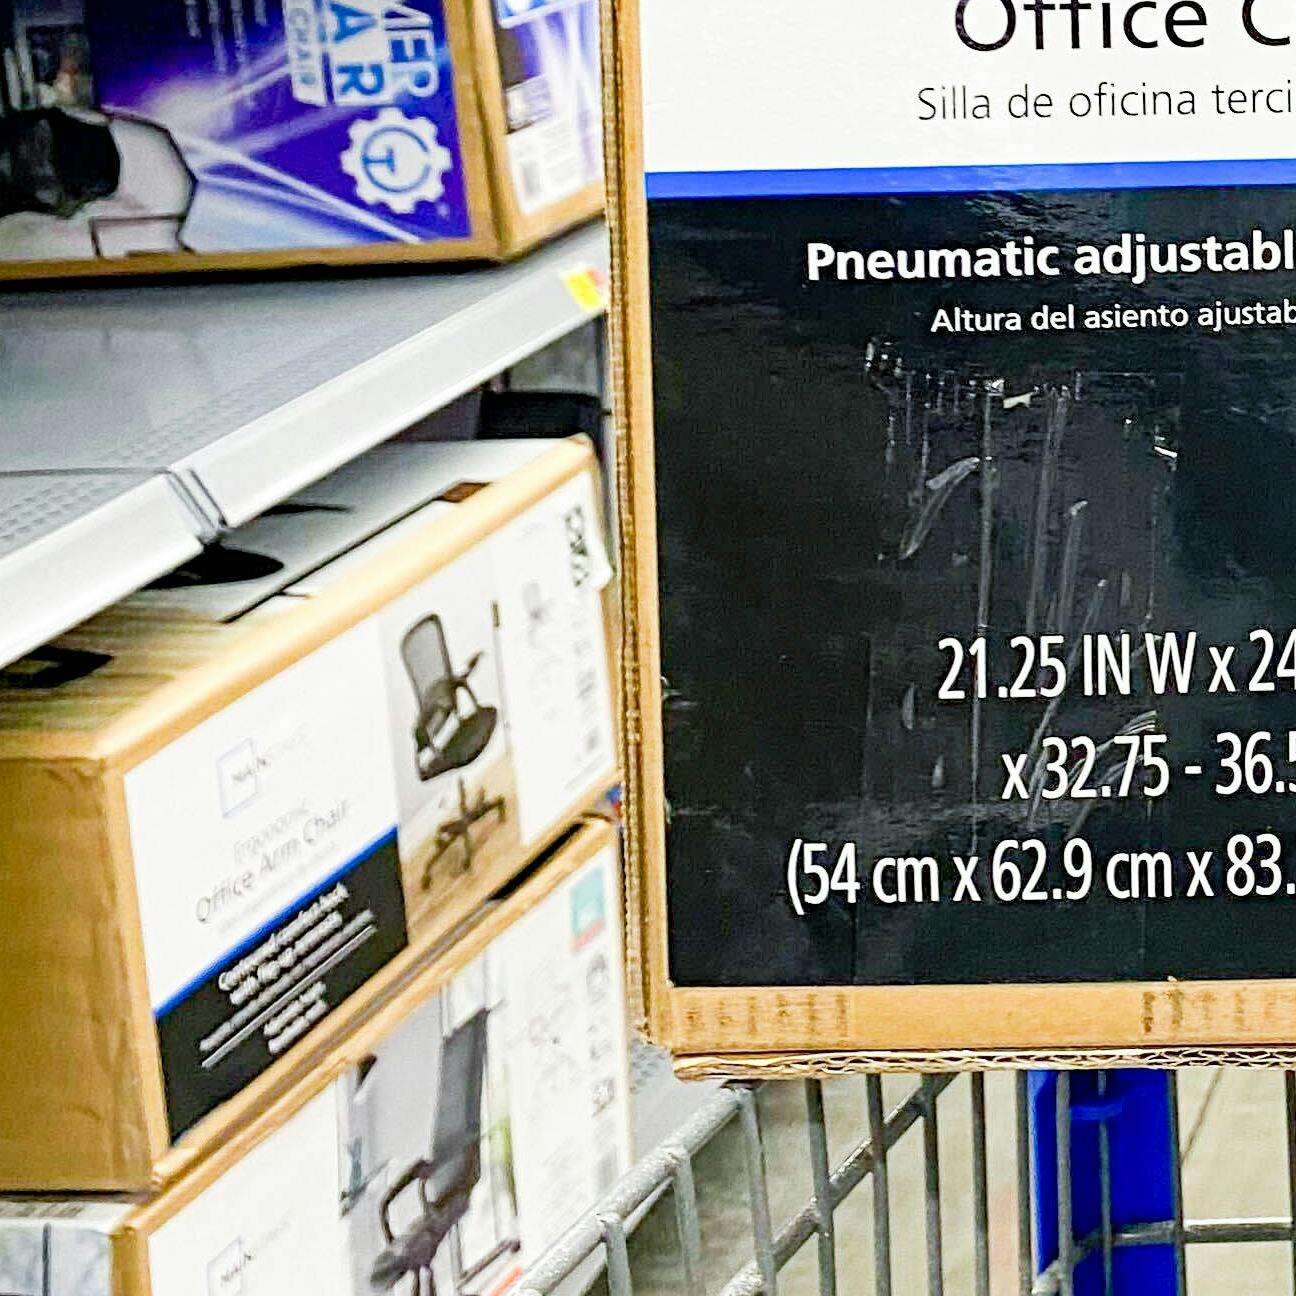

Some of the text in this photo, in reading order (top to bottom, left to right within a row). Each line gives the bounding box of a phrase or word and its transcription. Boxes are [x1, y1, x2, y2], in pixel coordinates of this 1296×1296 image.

[917, 85, 991, 121] Silla
[1008, 83, 1054, 119] de
[1069, 81, 1196, 118] oficina
[807, 236, 1060, 281] Pneumatic
[930, 306, 1022, 333] Altura
[1030, 303, 1075, 330] del
[1084, 303, 1189, 329] asiento
[938, 635, 1067, 700] 21.25
[1083, 633, 1131, 696] IN
[1144, 631, 1197, 694] W
[1208, 648, 1236, 693] x
[1001, 753, 1029, 800] x
[1041, 734, 1169, 799] 32.75
[787, 838, 861, 915] (54
[873, 856, 940, 903] cm
[952, 856, 980, 902] x
[992, 837, 1092, 901] 62.9
[1106, 851, 1173, 899] cm
[1186, 851, 1215, 897] x
